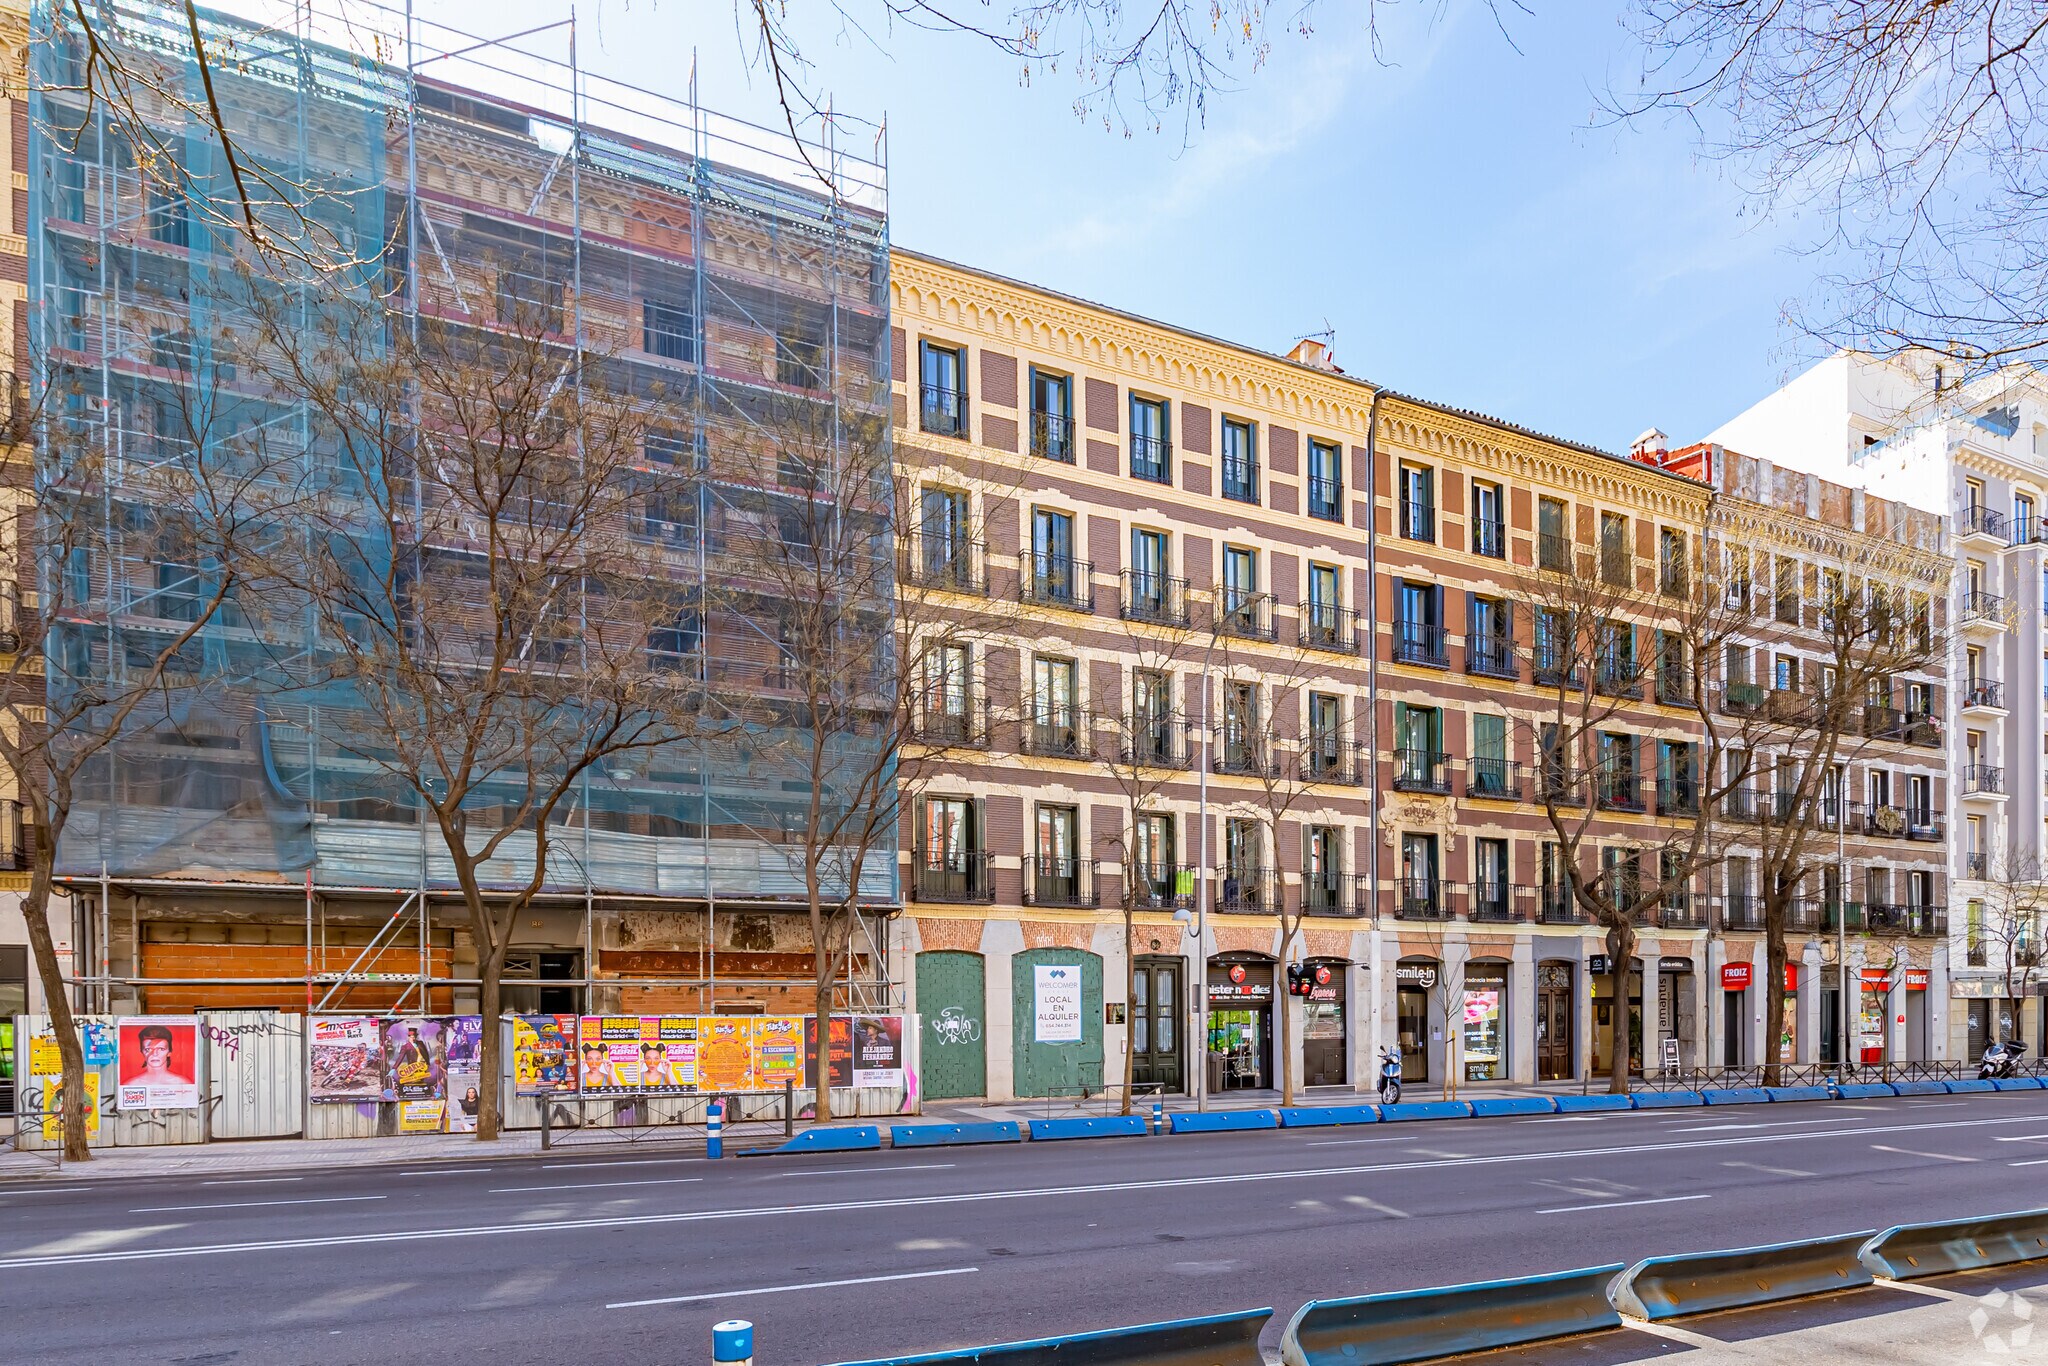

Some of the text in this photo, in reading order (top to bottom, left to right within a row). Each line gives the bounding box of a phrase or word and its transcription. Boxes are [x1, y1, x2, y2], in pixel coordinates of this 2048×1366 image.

[1396, 966, 1435, 979] smile-in
[1725, 968, 1747, 977] FROIZ
[1907, 974, 1927, 984] FROIZ
[1309, 986, 1336, 1000] Express
[1659, 978, 1667, 1027] amantis
[1038, 1013, 1079, 1021] ALQUILER
[463, 1022, 481, 1030] ELV
